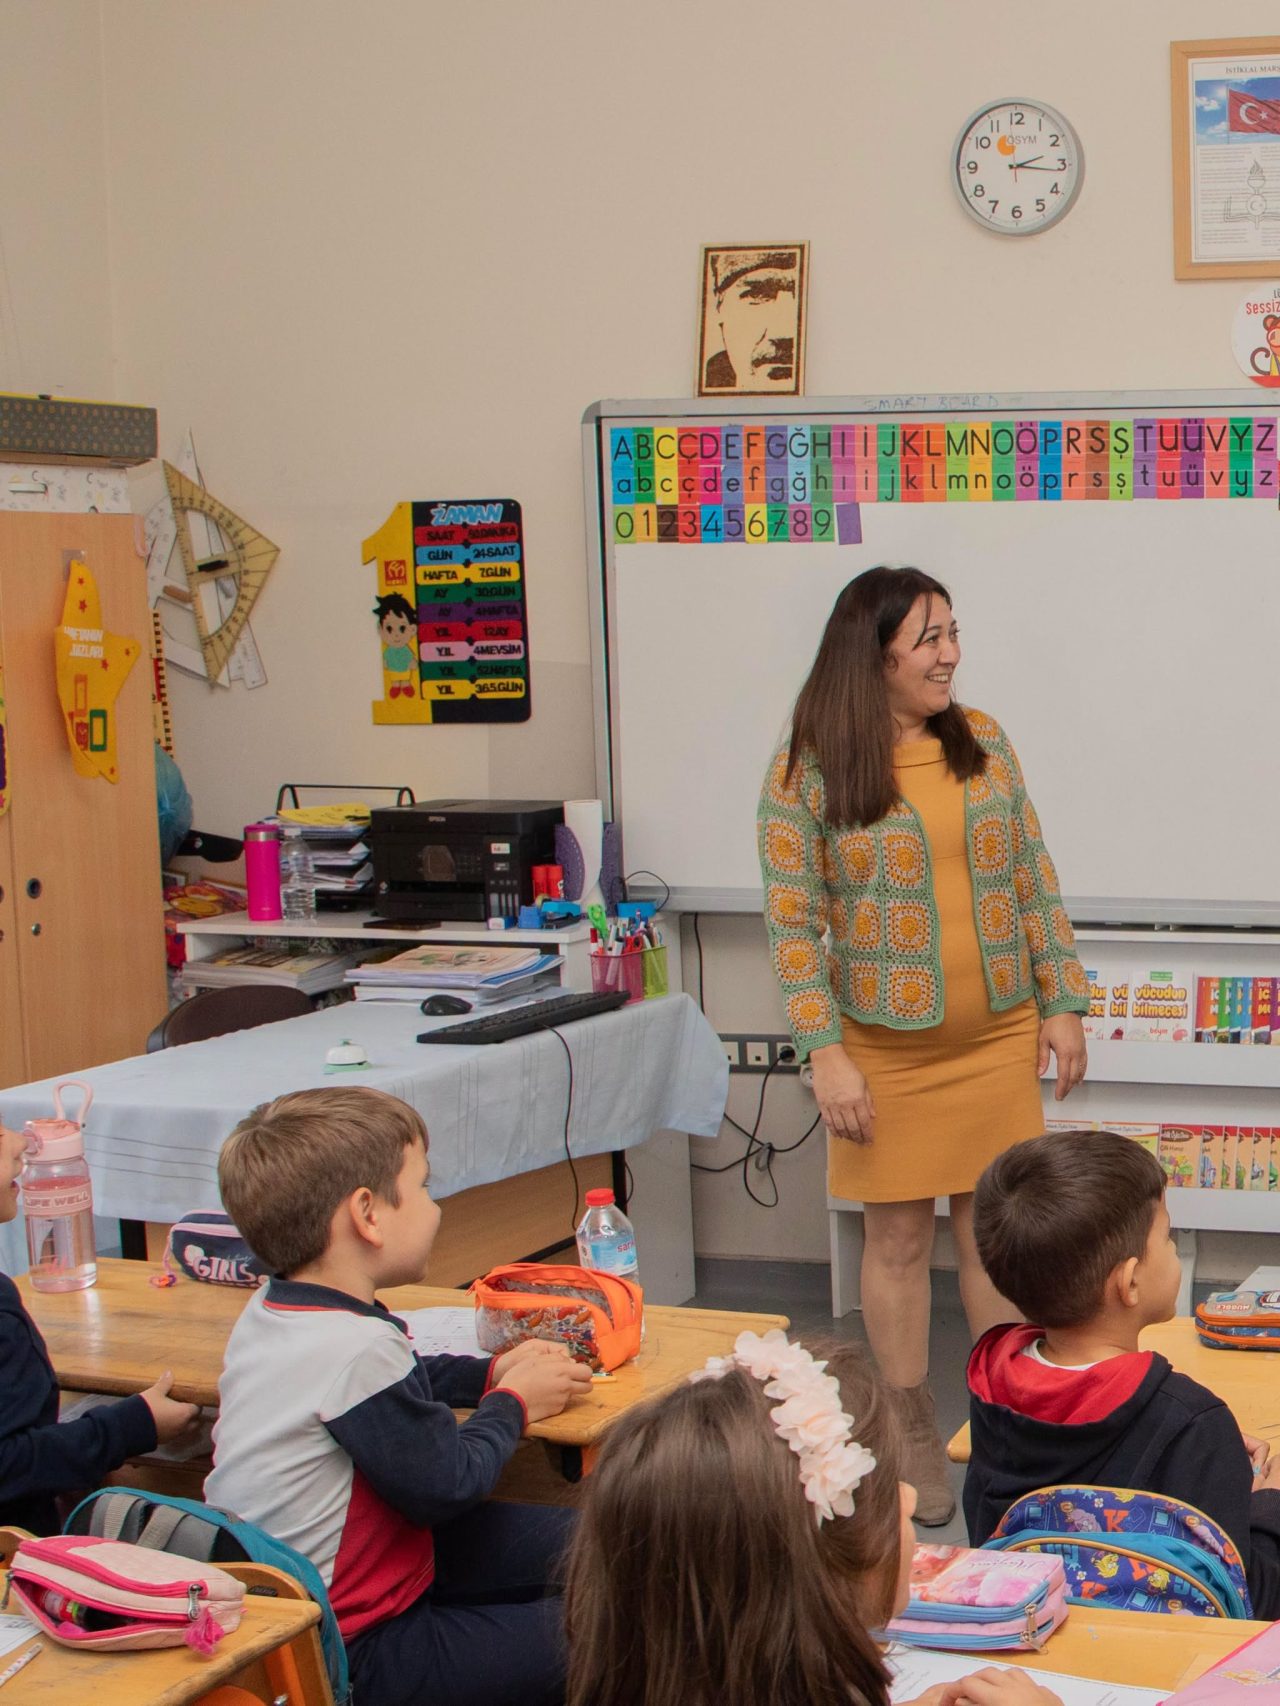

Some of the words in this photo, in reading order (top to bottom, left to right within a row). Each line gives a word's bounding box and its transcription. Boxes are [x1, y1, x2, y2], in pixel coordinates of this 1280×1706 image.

[990, 119, 1000, 133] 11
[1010, 112, 1025, 126] 12
[975, 136, 991, 150] 10
[1049, 134, 1060, 147] 2
[966, 160, 979, 174] 9
[1057, 158, 1067, 172] 3
[973, 184, 986, 198] 8
[1049, 182, 1061, 196] 4
[988, 199, 999, 214] 7
[1011, 205, 1023, 219] 6
[1035, 199, 1046, 212] 5
[1246, 299, 1280, 315] Sessiz
[430, 503, 503, 526] ZAMAN
[427, 550, 453, 561] GÜN
[423, 570, 458, 580] HAFTA
[436, 646, 454, 657] YIL
[436, 685, 455, 695] YIL
[1134, 984, 1187, 1001] vücudun
[1132, 1001, 1188, 1019] bilmecesi
[193, 1255, 257, 1282] GIRLS
